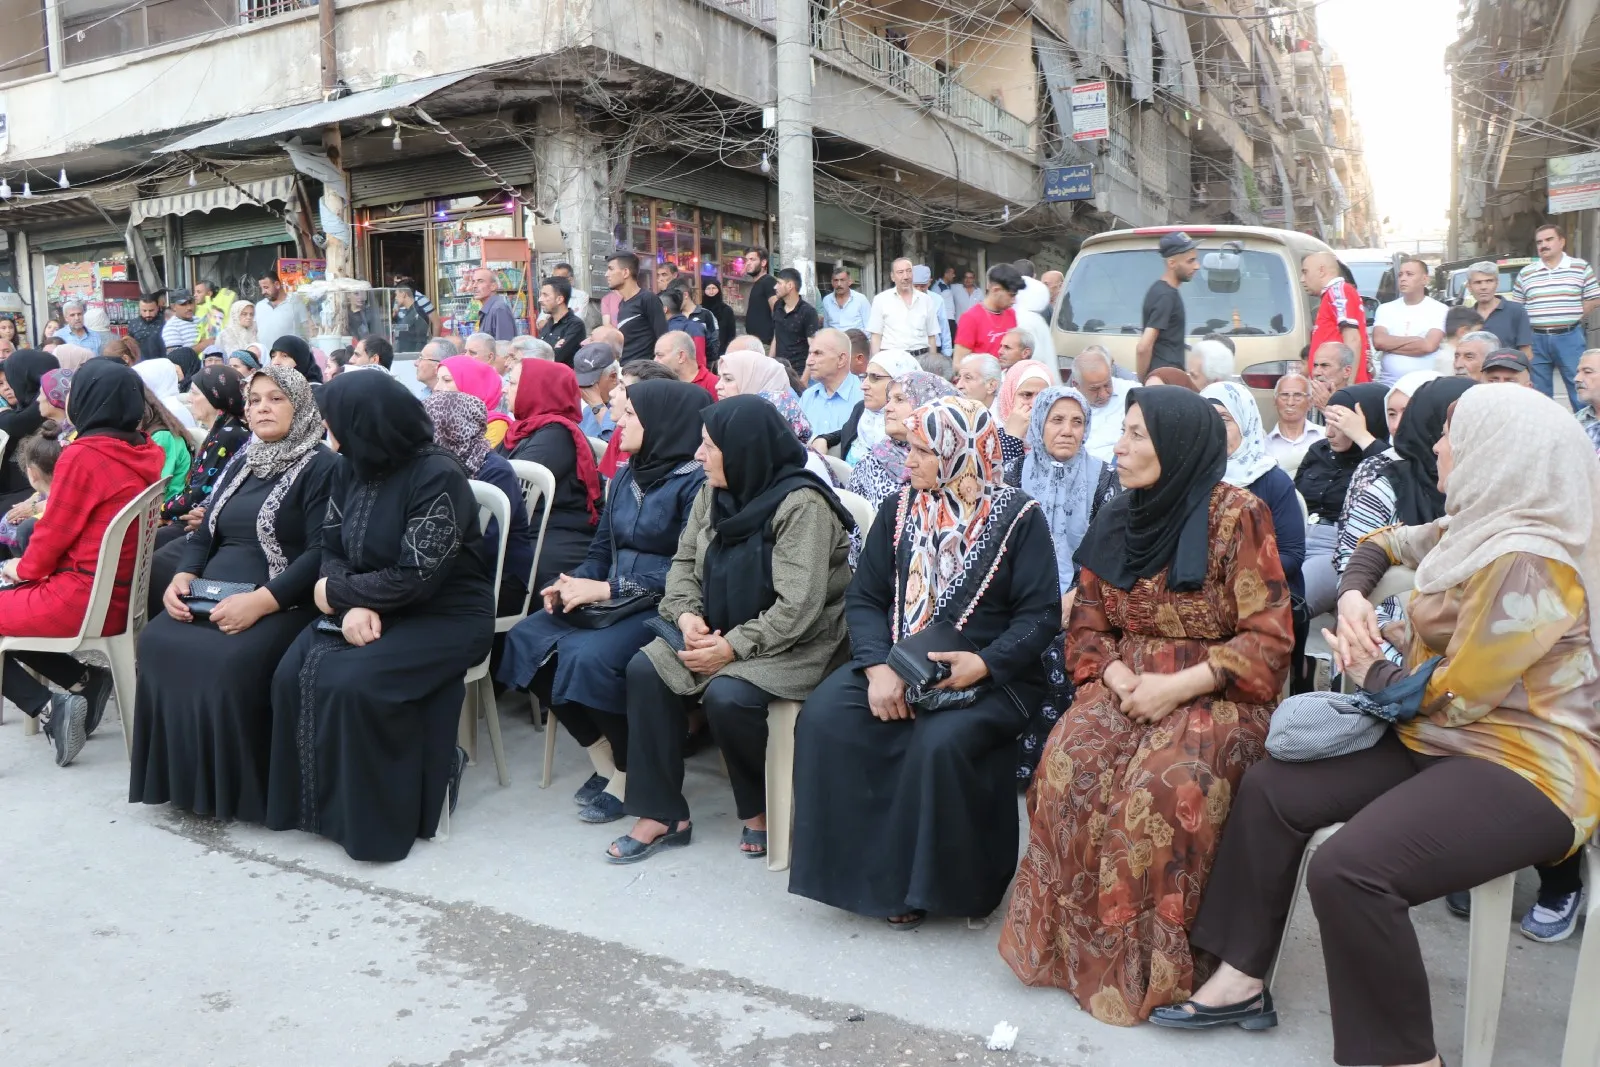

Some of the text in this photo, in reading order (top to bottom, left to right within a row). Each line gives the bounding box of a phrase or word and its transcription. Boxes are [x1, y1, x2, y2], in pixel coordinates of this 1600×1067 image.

[1062, 169, 1089, 181] المحامي
[1047, 185, 1062, 197] رشيد
[1062, 185, 1077, 197] حسين
